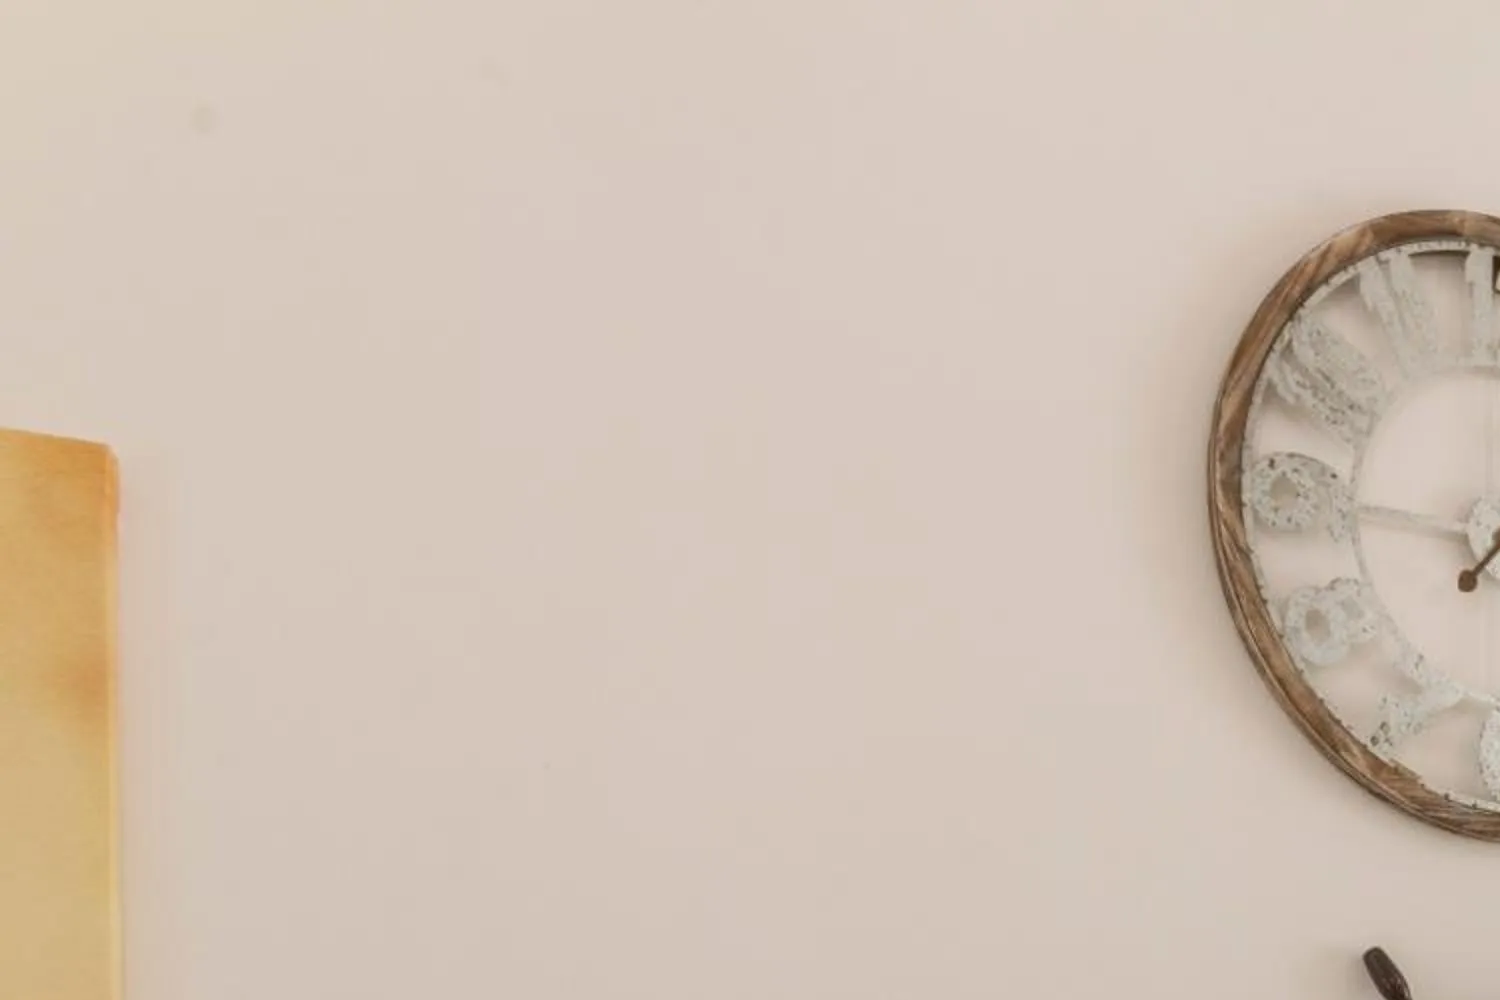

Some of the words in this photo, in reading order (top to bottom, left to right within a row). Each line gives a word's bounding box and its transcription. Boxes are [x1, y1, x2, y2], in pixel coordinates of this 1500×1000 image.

[1250, 451, 1355, 541] 9
[1283, 576, 1376, 666] 8
[1370, 645, 1463, 758] 7
